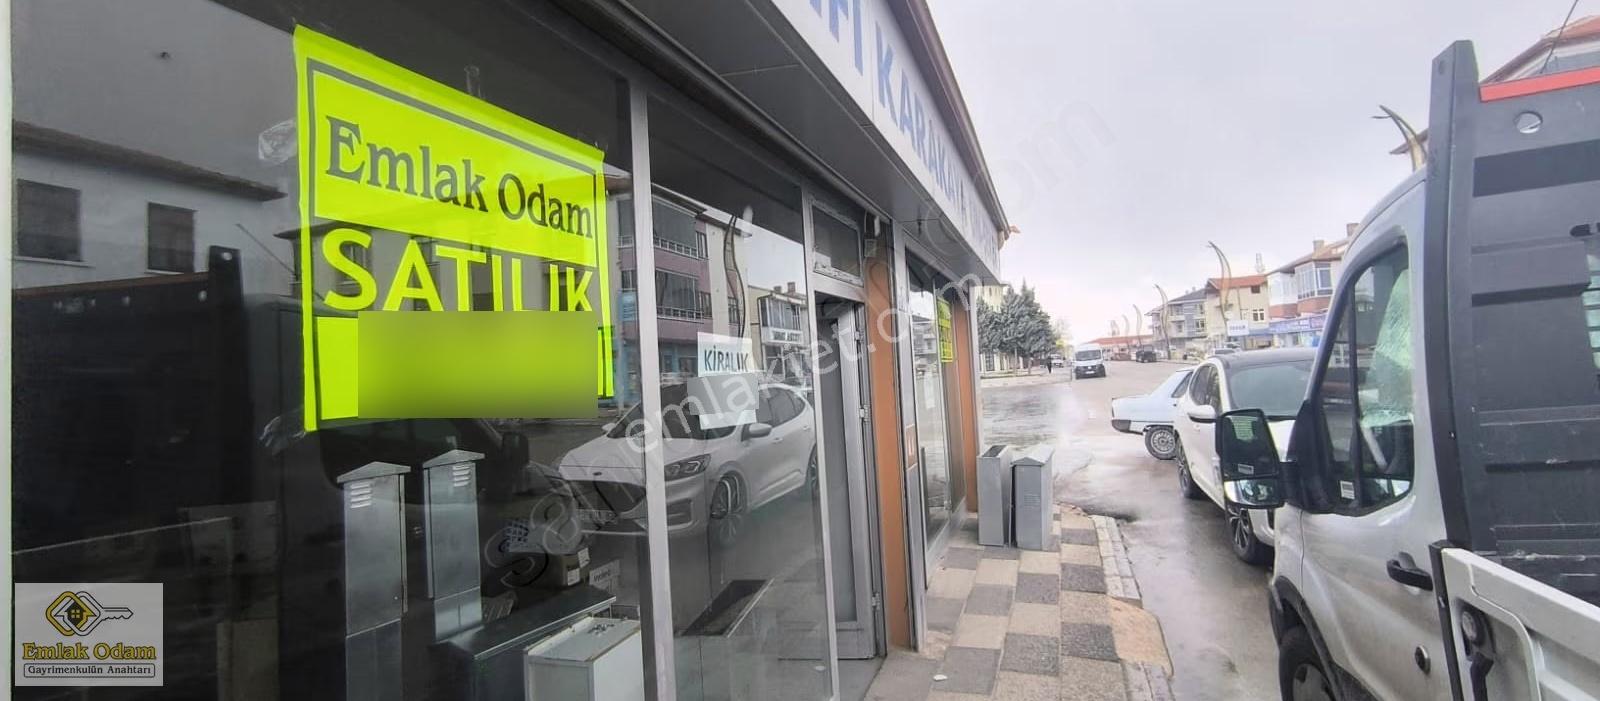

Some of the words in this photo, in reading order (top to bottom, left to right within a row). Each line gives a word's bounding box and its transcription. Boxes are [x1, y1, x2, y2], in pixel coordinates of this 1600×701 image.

[325, 115, 488, 213] Emlak
[498, 173, 594, 239] Odam
[321, 227, 593, 312] SATILIK
[704, 345, 749, 372] KİRALIK
